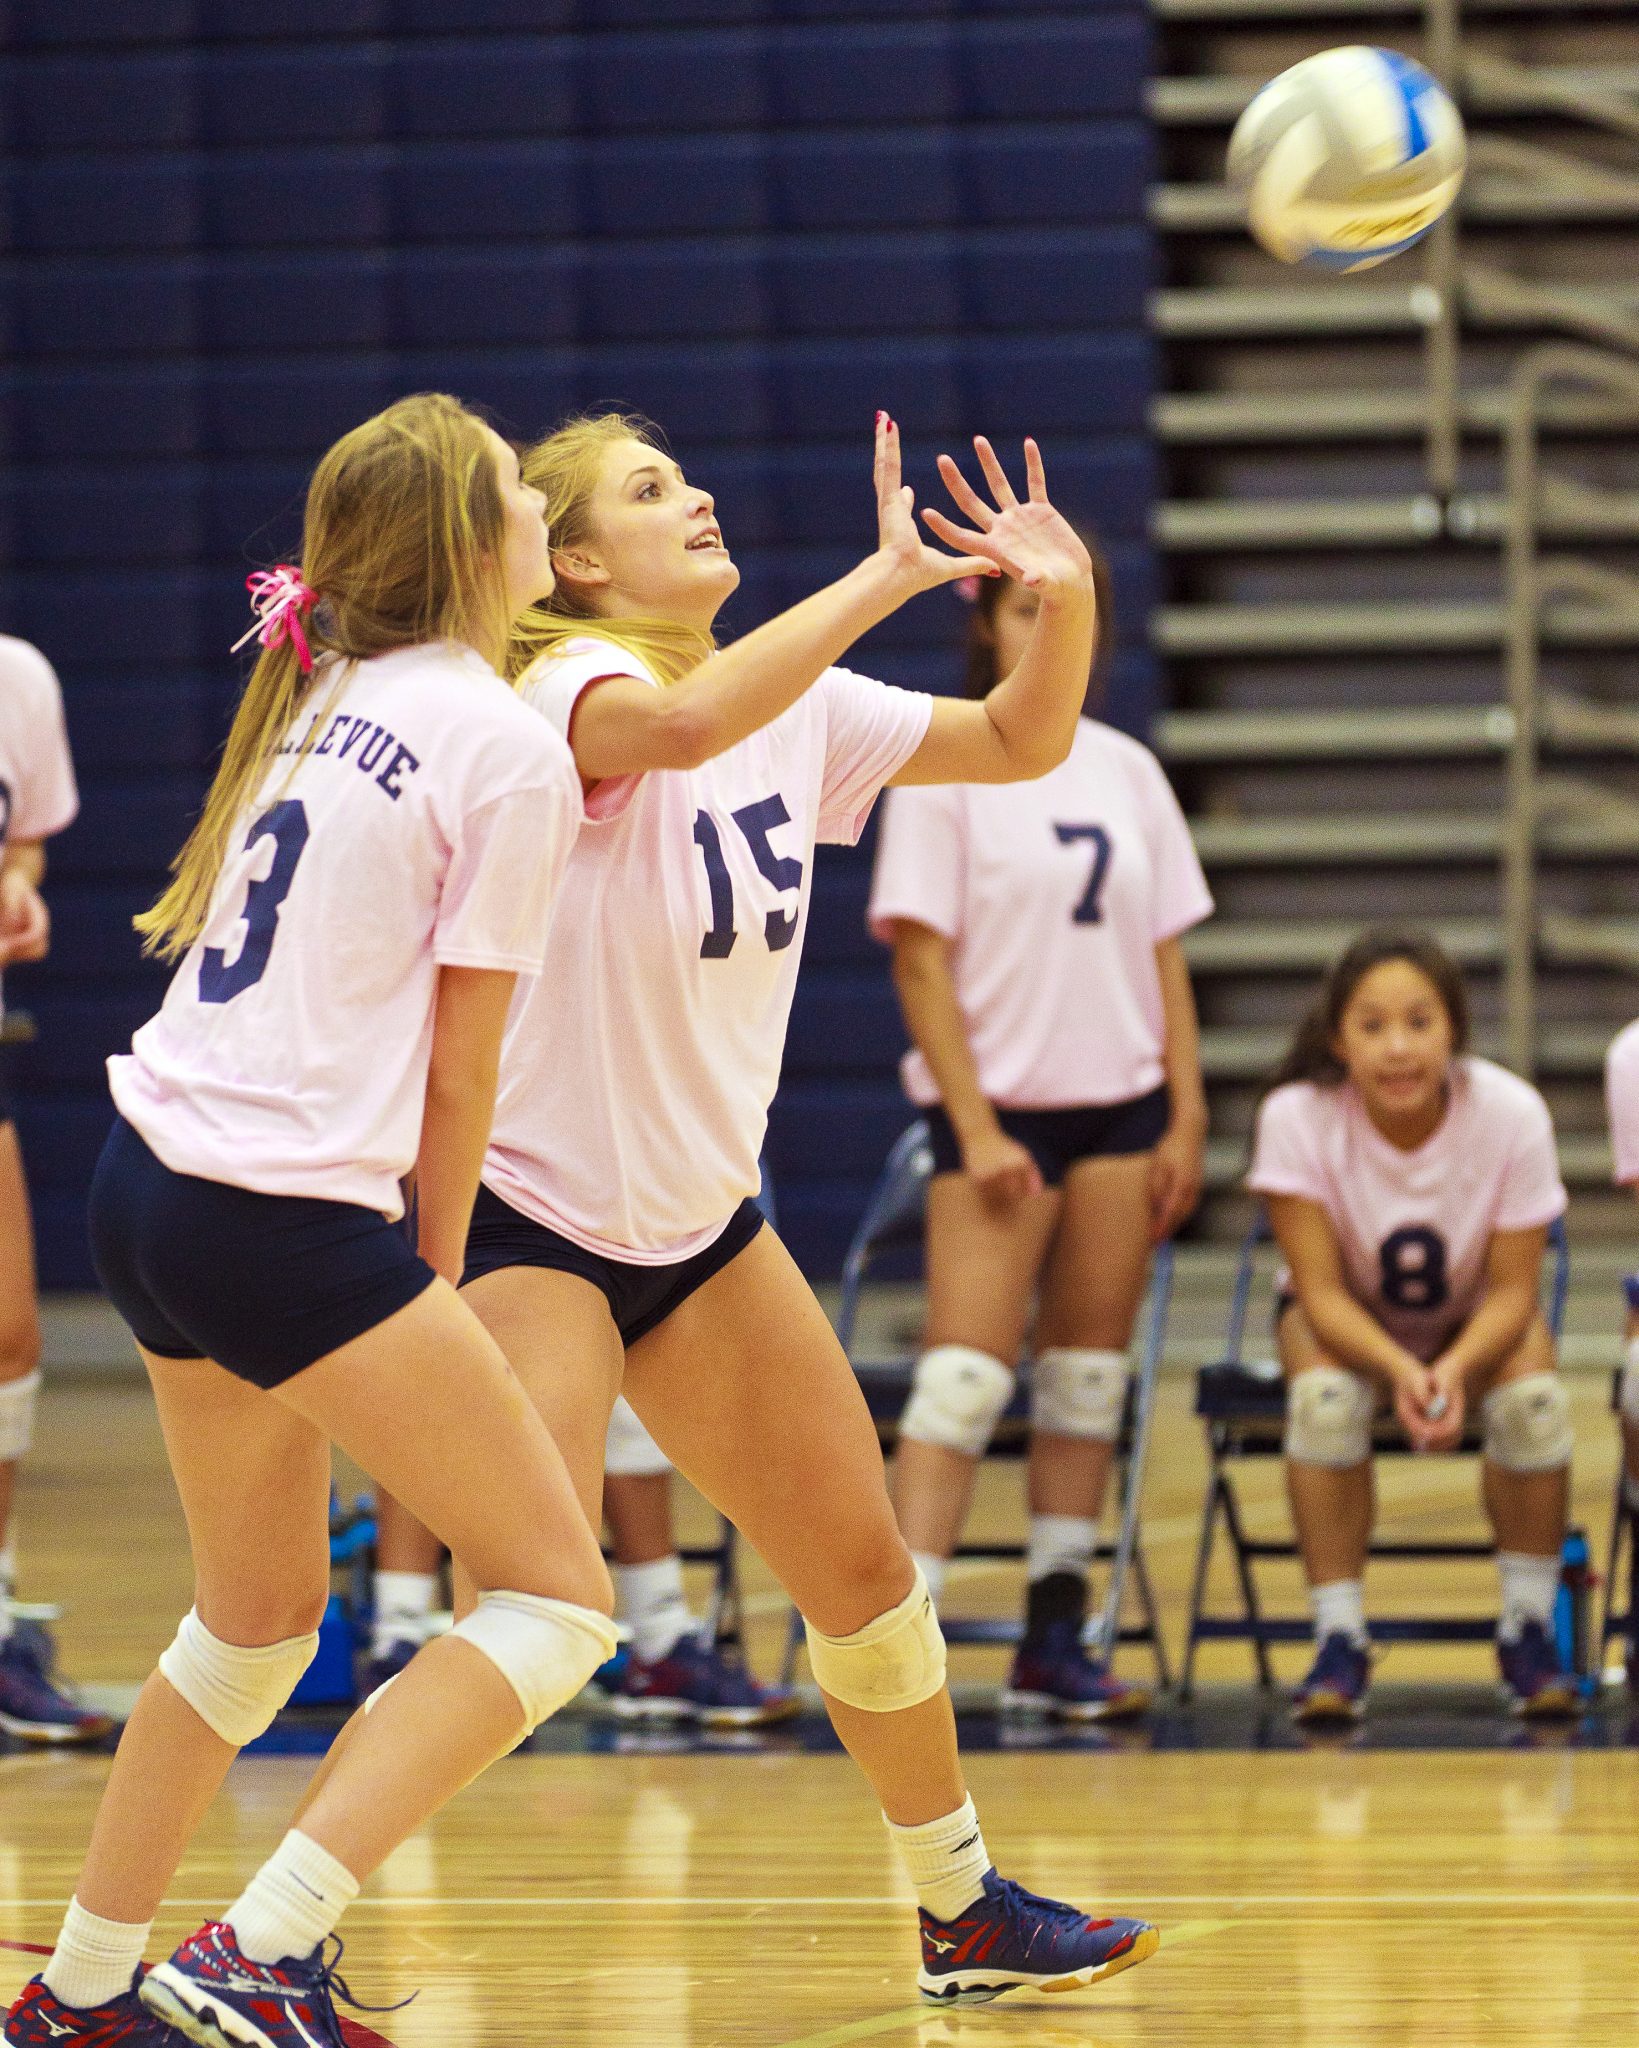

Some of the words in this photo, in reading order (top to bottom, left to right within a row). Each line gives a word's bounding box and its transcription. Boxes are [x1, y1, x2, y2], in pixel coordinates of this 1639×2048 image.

[198, 798, 311, 1004] 3
[693, 792, 804, 959] 15
[1052, 822, 1113, 925] 7
[1380, 1226, 1448, 1311] 8
